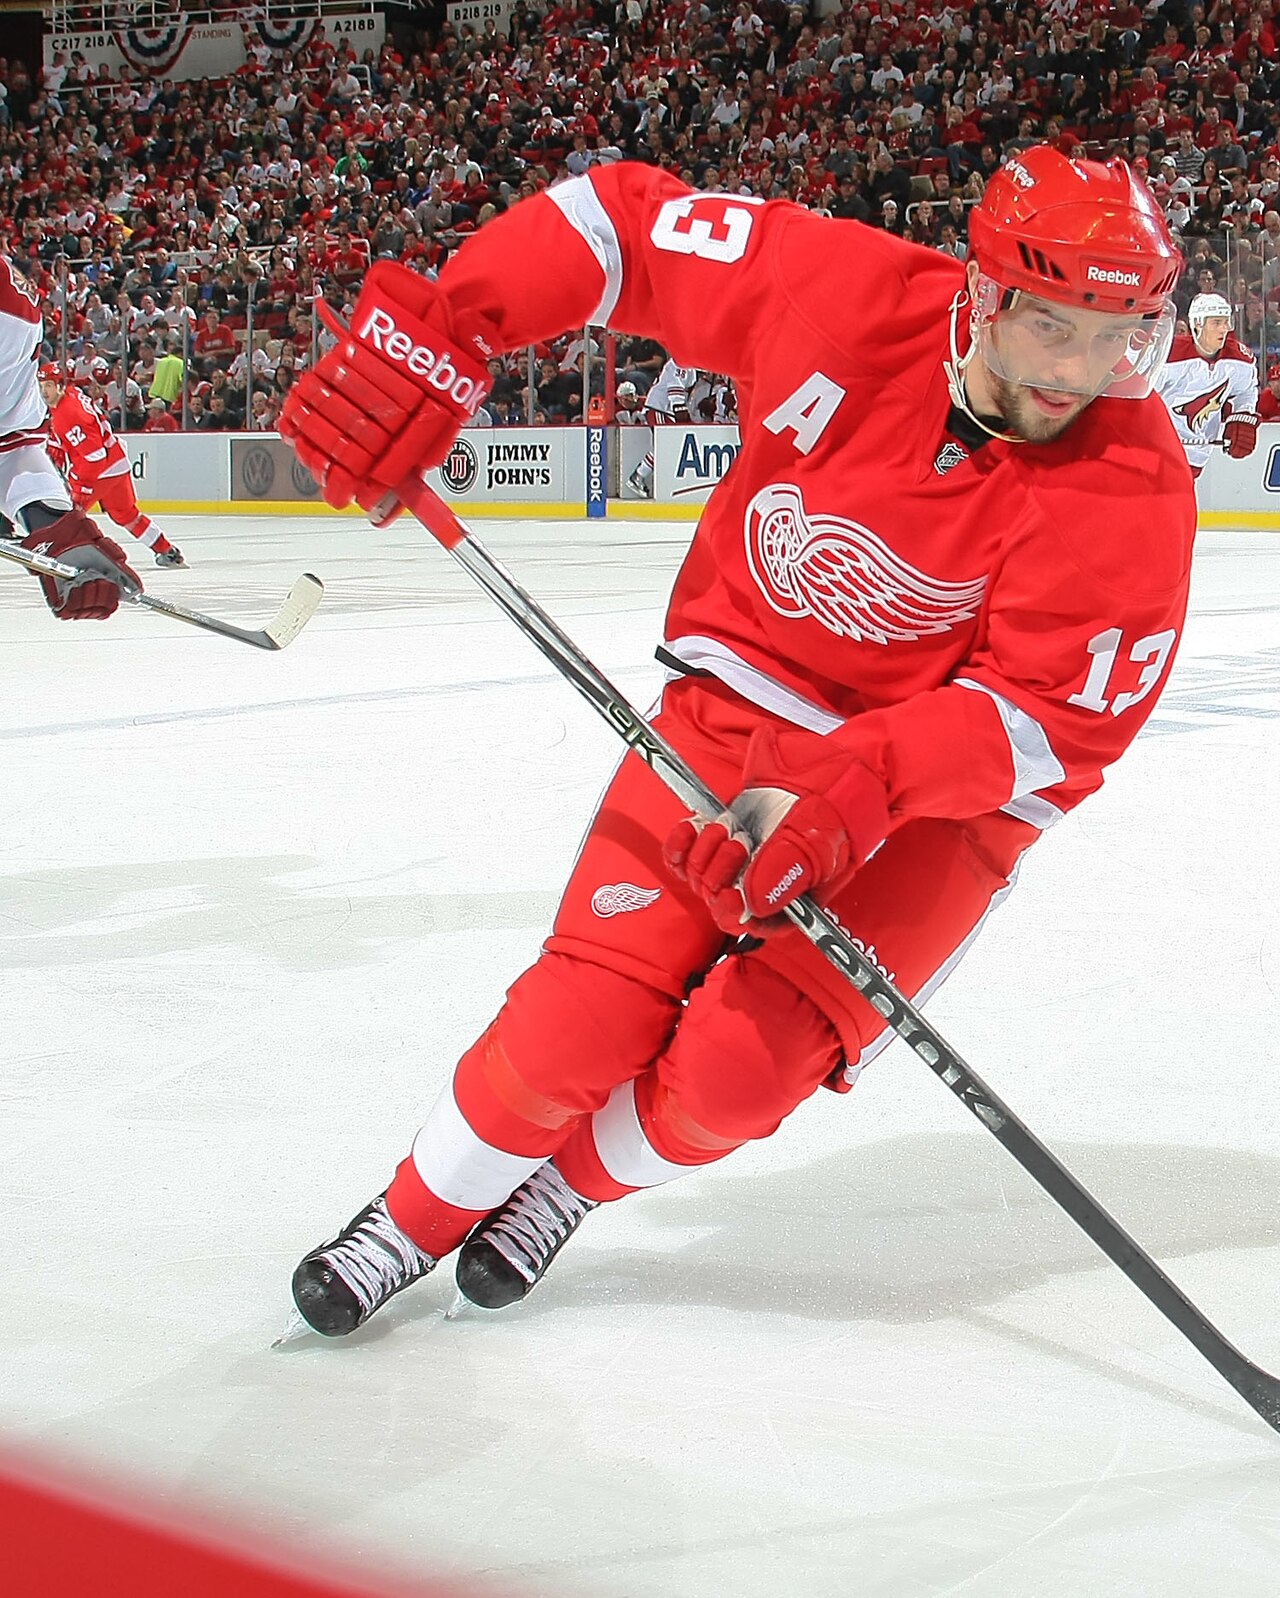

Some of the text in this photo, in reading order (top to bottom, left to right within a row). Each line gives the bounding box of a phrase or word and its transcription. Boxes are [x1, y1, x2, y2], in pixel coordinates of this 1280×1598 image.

[483, 4, 501, 17] 219
[191, 29, 232, 40] STANDING
[1087, 265, 1141, 287] Reebok
[359, 305, 487, 416] Reebok
[762, 370, 847, 456] A
[64, 425, 87, 447] 52
[487, 444, 550, 466] JIMMY
[589, 428, 603, 502] Reebok
[487, 468, 550, 490] JOHN'S
[1066, 627, 1177, 718] 13
[765, 862, 804, 905] Reebok
[783, 896, 1000, 1120] eebok
